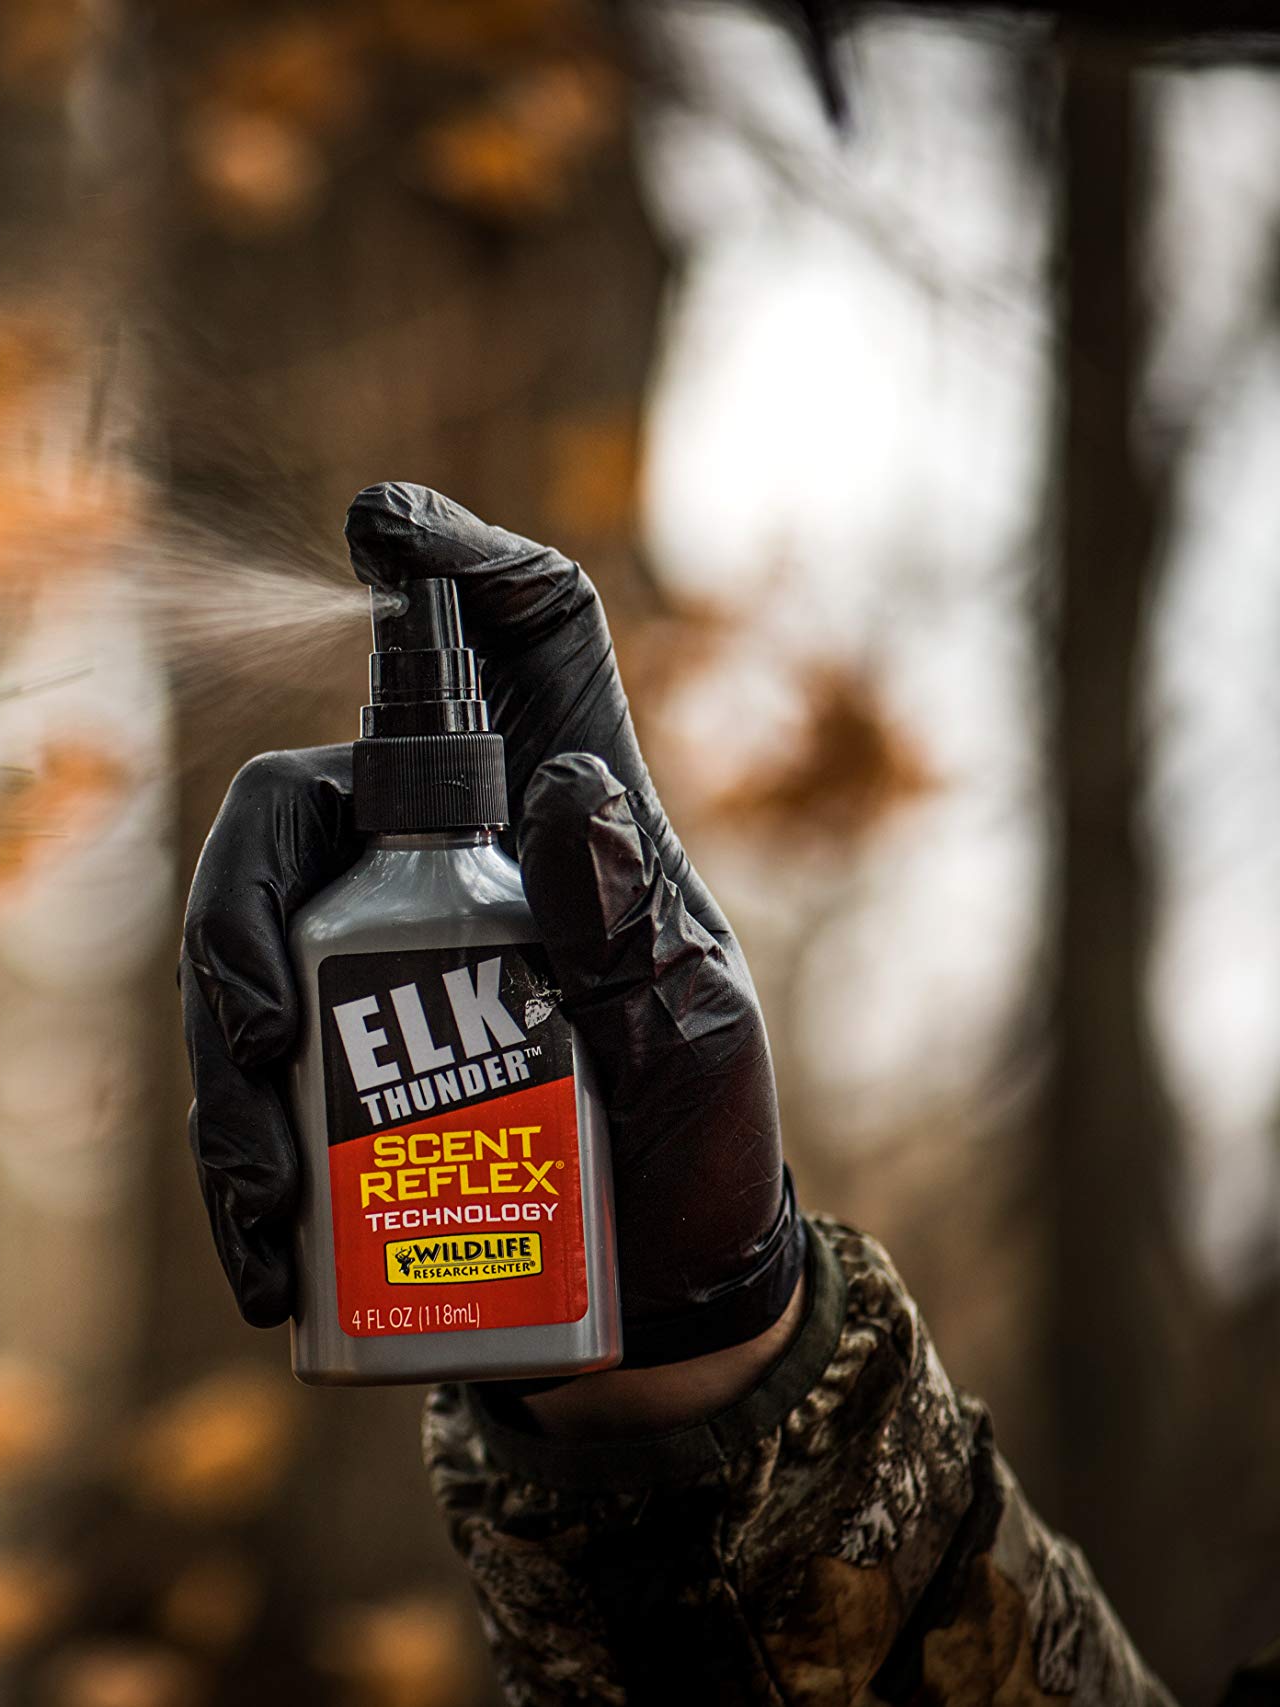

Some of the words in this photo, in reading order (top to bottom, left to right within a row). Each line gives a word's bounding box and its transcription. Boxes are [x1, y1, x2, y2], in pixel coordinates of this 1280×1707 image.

[332, 956, 527, 1092] ELK
[373, 1126, 542, 1168] SCENT
[365, 1203, 559, 1232] TECHNOLOGY
[413, 1236, 532, 1264] WILDLIFE
[413, 1265, 479, 1279] RESEARCH
[351, 1310, 362, 1330] 4
[367, 1309, 385, 1329] FL
[389, 1306, 413, 1328] OZ
[418, 1302, 481, 1332] (118mL)
